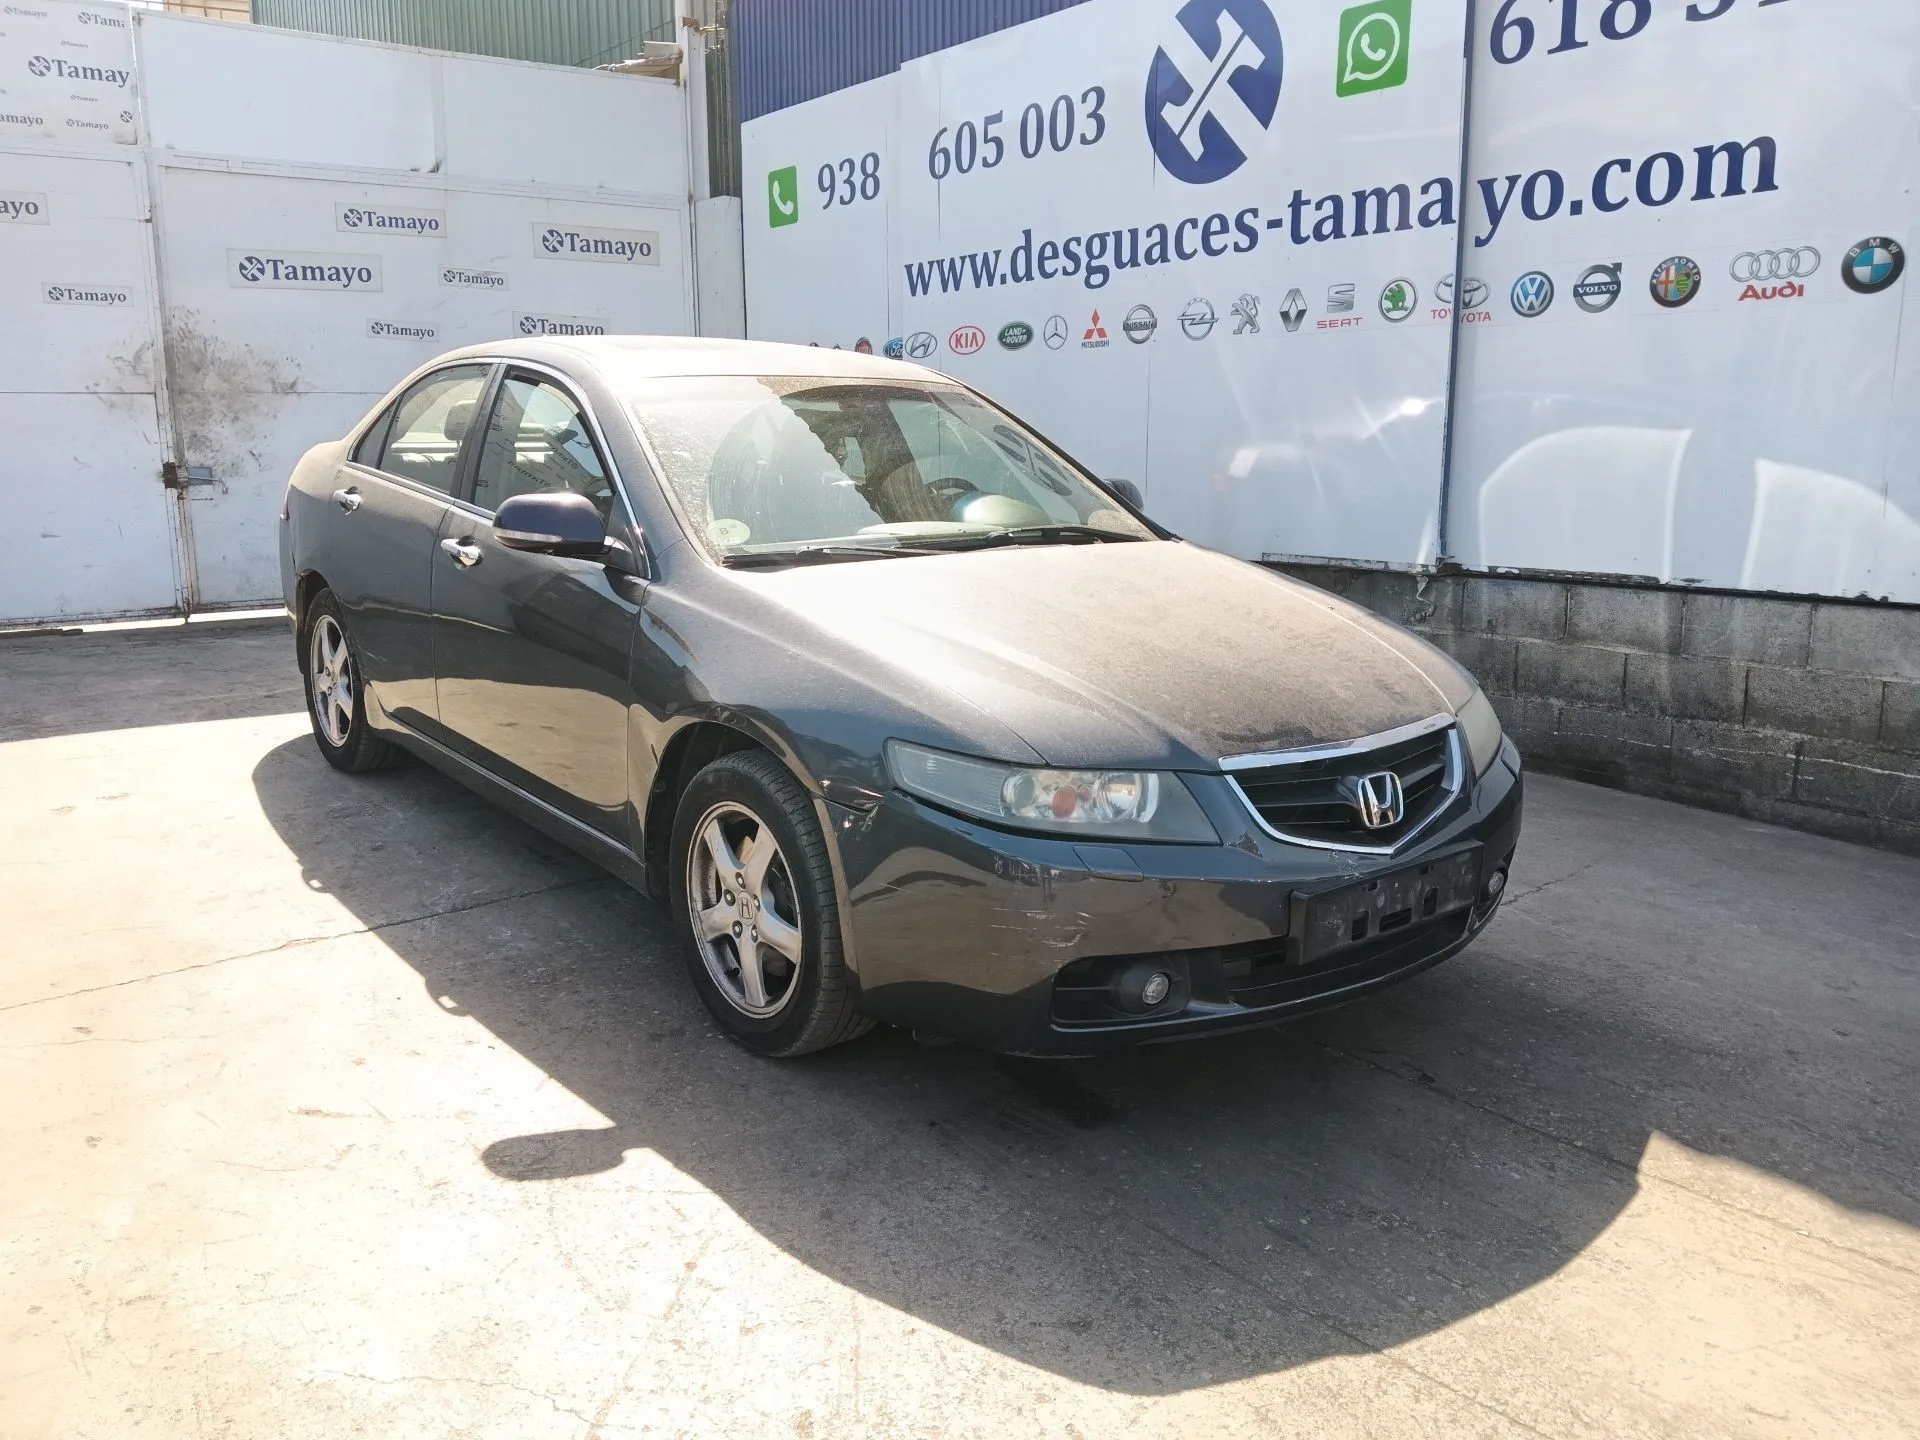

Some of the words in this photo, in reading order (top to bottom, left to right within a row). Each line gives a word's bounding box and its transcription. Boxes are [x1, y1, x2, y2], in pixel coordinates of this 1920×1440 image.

[51, 59, 129, 88] Tamay
[75, 119, 109, 131] Tamayo
[817, 151, 880, 210] 938
[928, 109, 1004, 180] 605
[1019, 85, 1106, 159] 003
[364, 210, 440, 234] Tamayo
[904, 135, 1779, 297] www.desguaces-tamayo.com
[564, 231, 652, 261] Tamayo
[1848, 238, 1900, 257] BMW
[266, 258, 373, 288] Tamayo
[455, 271, 504, 288] Tamayo
[64, 288, 127, 305] Tamayo
[1576, 283, 1618, 295] VOLVO
[1737, 280, 1805, 302] Audi
[384, 323, 435, 339] Tamayo
[1004, 326, 1022, 337] LAND
[1125, 320, 1153, 330] NISSAN
[1316, 317, 1364, 329] SEAT
[954, 332, 980, 349] KIA
[1006, 334, 1028, 344] ROVER
[1081, 340, 1110, 350] MITSUBISHI
